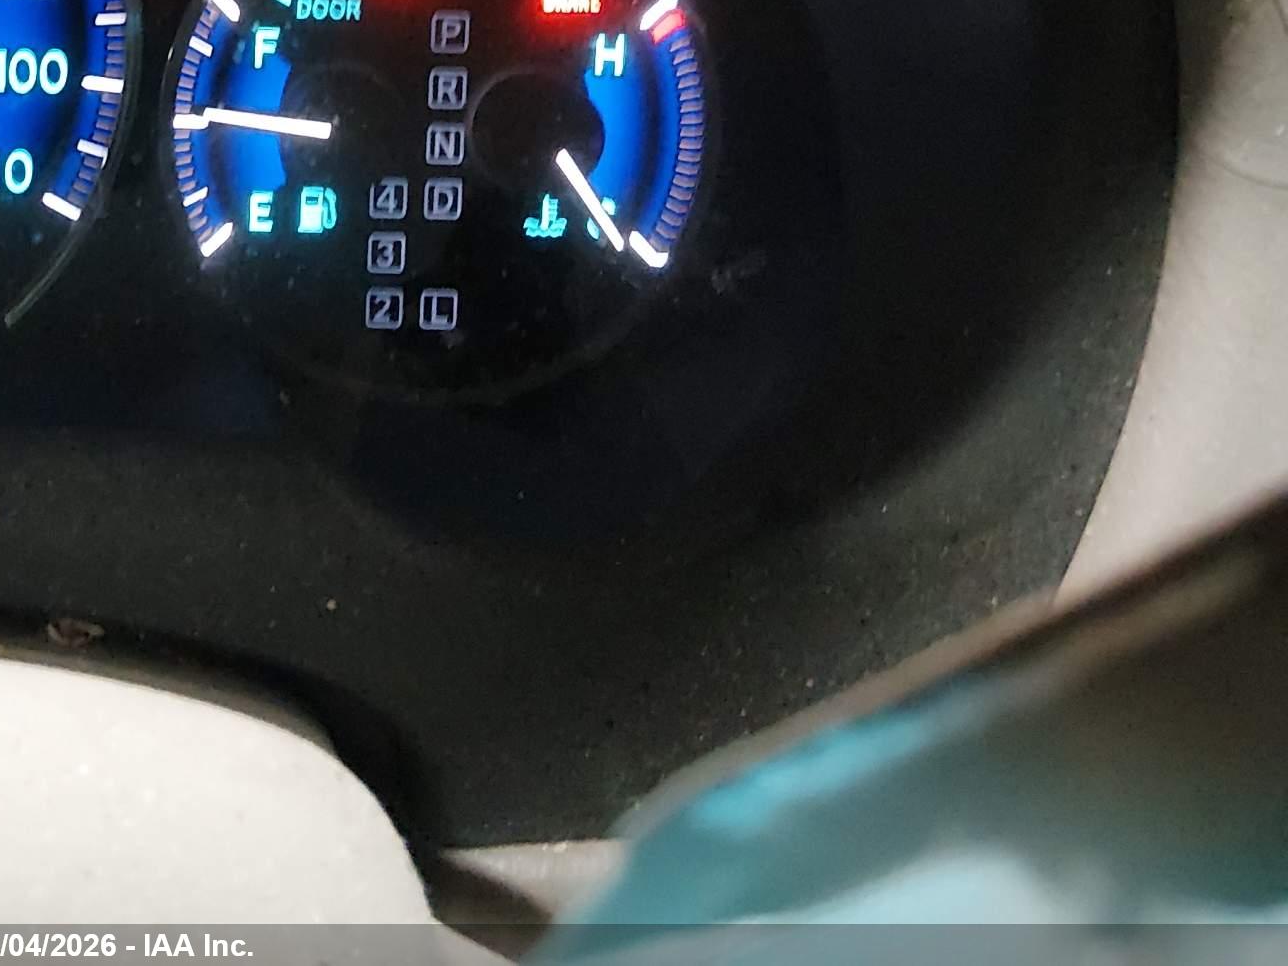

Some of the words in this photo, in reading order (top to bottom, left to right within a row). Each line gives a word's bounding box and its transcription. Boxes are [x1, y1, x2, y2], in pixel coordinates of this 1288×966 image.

[252, 23, 281, 69] F
[441, 19, 461, 49] P
[594, 32, 625, 77] H
[437, 77, 458, 106] R
[434, 132, 455, 159] N
[248, 189, 274, 233] E
[376, 187, 398, 214] 4
[433, 187, 453, 215] D
[376, 242, 394, 267] 3
[373, 296, 392, 324] 2
[431, 295, 449, 324] L
